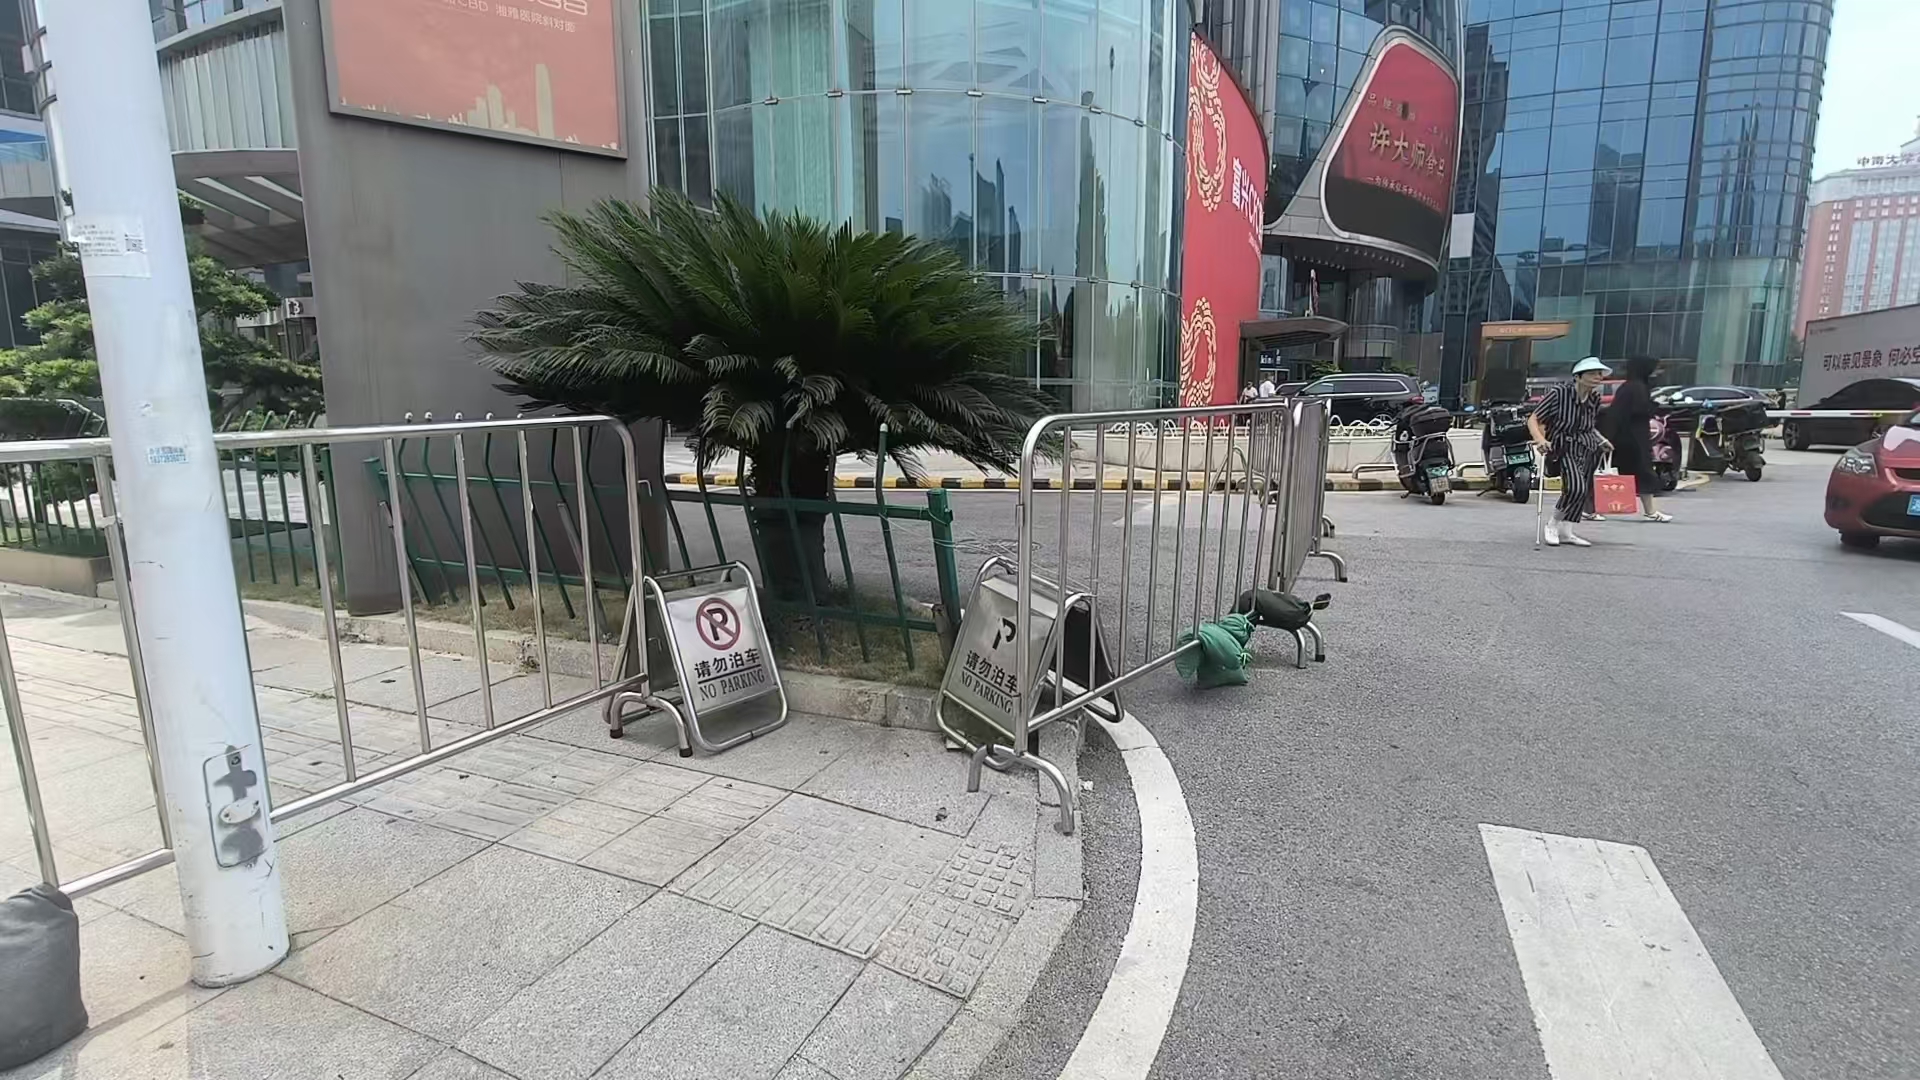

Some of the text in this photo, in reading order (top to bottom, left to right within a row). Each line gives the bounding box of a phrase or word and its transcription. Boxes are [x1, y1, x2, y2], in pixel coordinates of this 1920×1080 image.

[496, 3, 576, 33] 湘雅医院斜对面
[1823, 350, 1882, 371] 可以亲见景象
[694, 648, 760, 679] 请勿泊车
[966, 650, 1017, 693] 请勿泊车
[700, 668, 765, 701] NO PARKING
[961, 671, 1013, 714] NO PARKING
